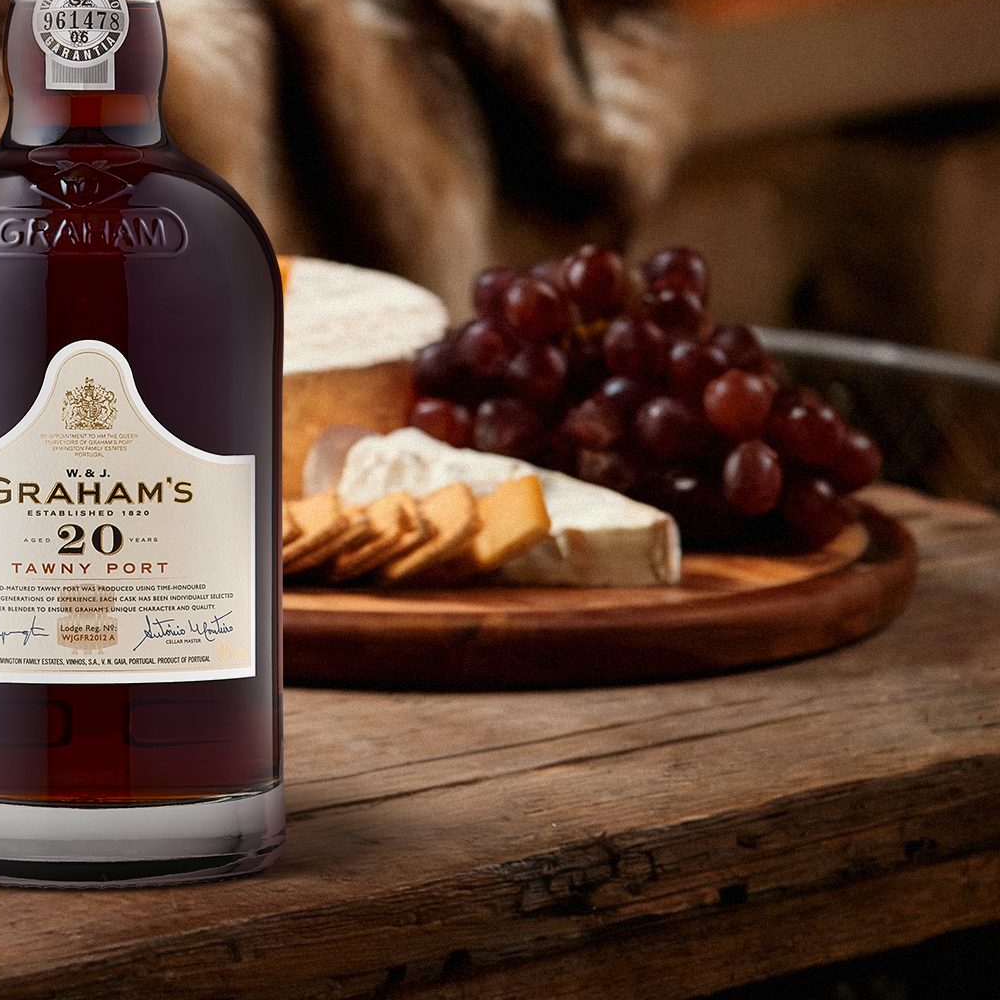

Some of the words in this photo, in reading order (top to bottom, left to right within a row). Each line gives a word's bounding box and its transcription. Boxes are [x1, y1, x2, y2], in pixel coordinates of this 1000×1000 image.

[43, 10, 120, 31] 961478
[70, 31, 89, 44] 06
[45, 36, 116, 61] GARANTIA
[66, 468, 82, 478] W.
[84, 468, 95, 478] &
[99, 468, 110, 478] J.
[27, 509, 114, 517] ESTABLISHED
[121, 509, 150, 517] 1820
[57, 523, 124, 556] 20
[11, 562, 91, 574] TAWNY
[106, 562, 168, 574] PORT
[210, 592, 234, 600] SELECTED
[60, 624, 83, 634] Lodge
[85, 625, 101, 634] Reg.
[61, 634, 107, 644] WJGFR2012
[41, 658, 65, 666] ESTATES,
[65, 658, 87, 666] VINHOS,
[157, 656, 180, 664] PRODUCT
[180, 656, 187, 664] OF
[188, 655, 210, 663] PORTUGAL
